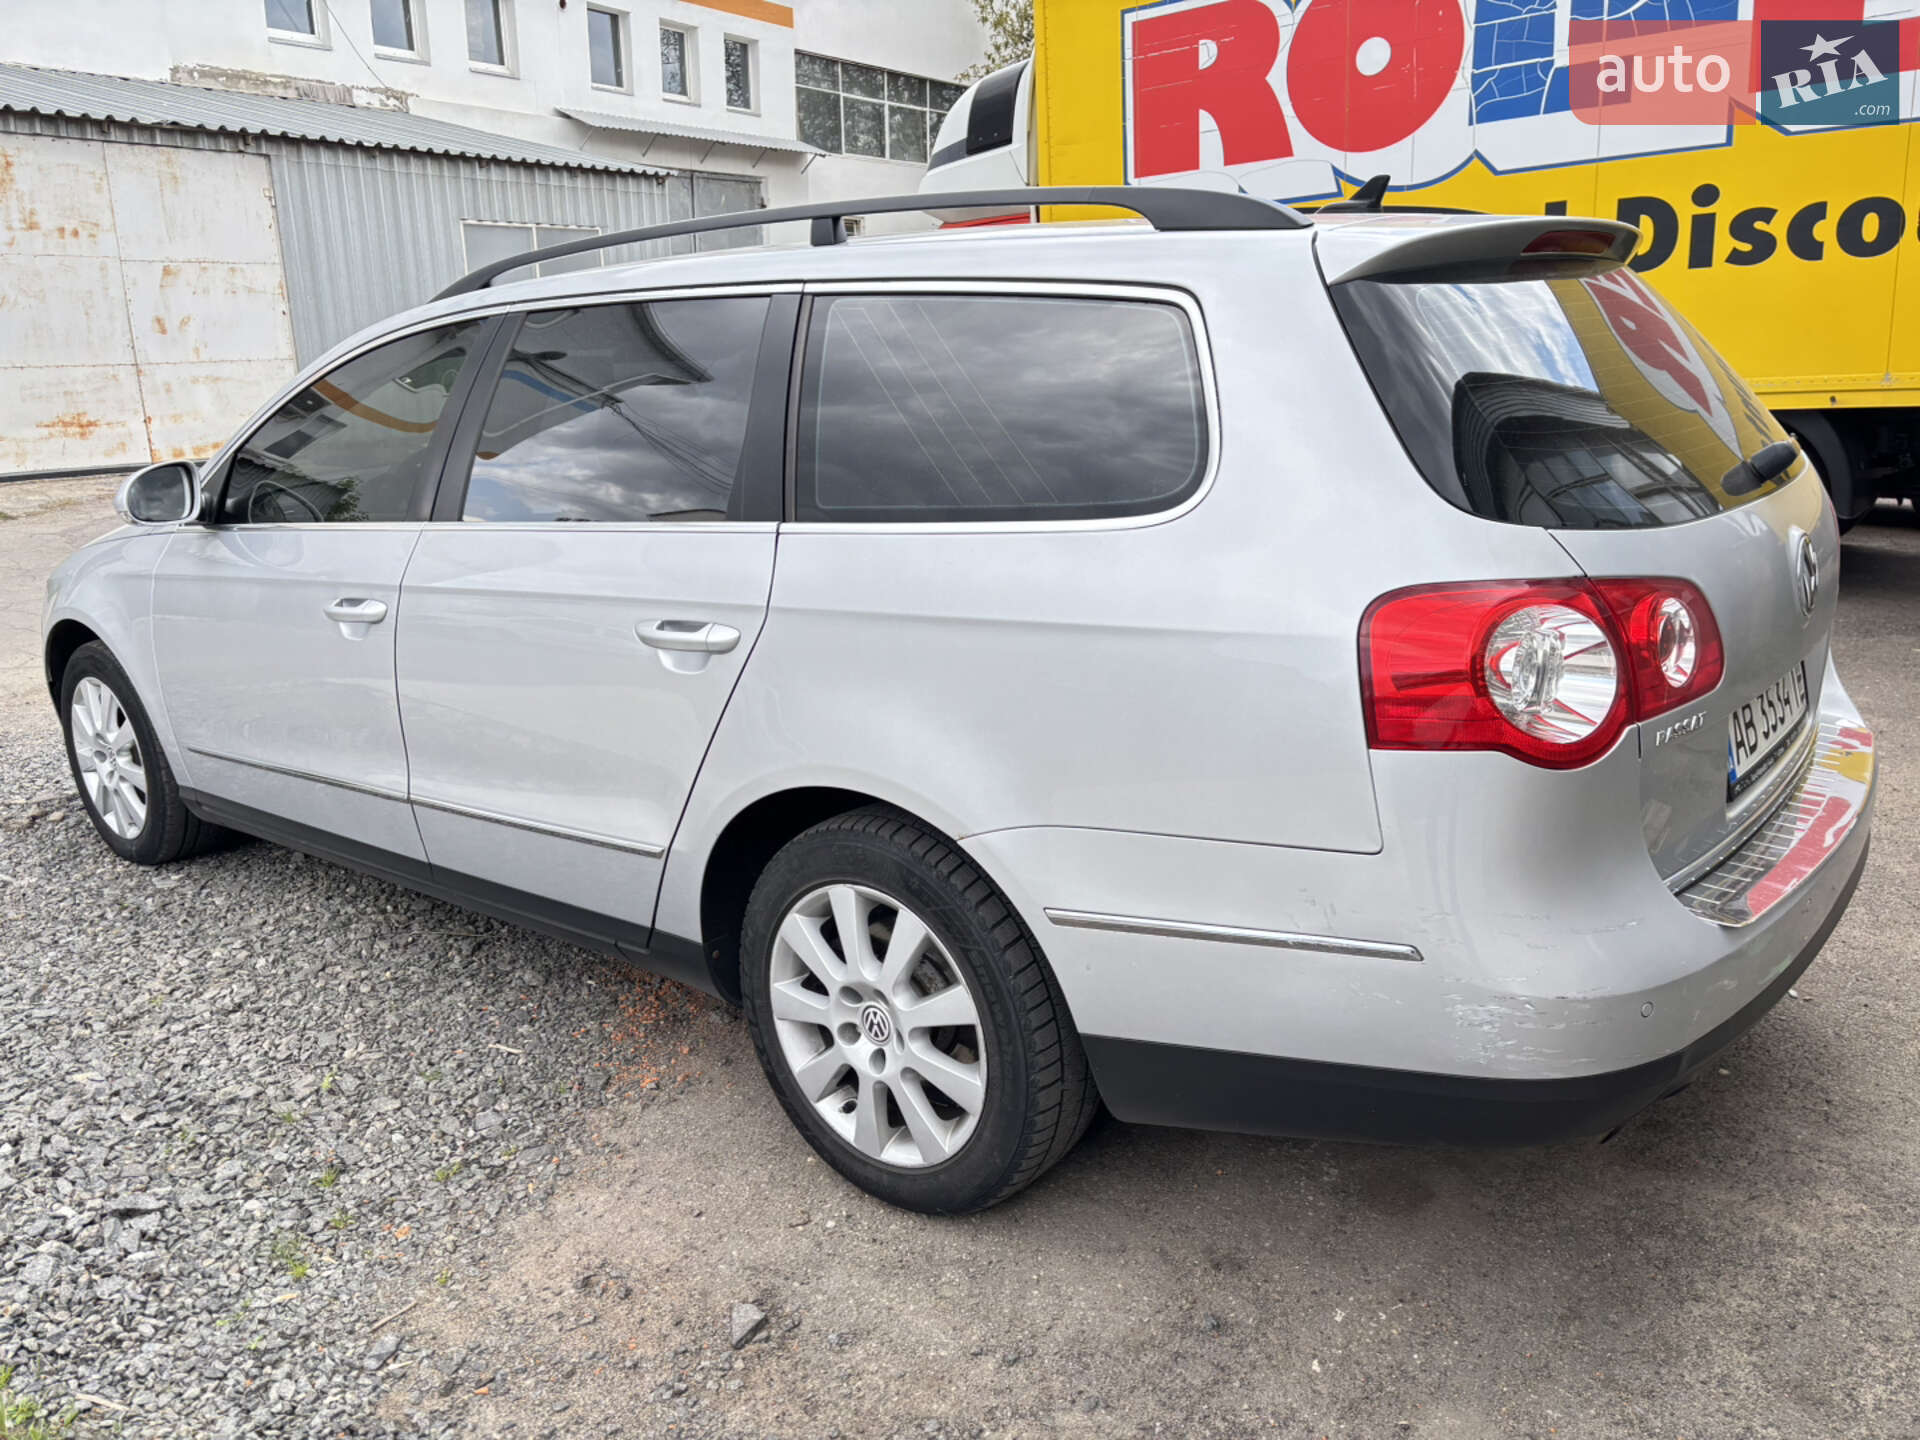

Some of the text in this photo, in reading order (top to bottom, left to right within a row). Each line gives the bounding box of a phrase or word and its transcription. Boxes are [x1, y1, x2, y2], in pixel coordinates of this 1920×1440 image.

[1616, 183, 1920, 273] Disco
[1656, 711, 1707, 747] PASSAT
[1733, 704, 1758, 766] AB
